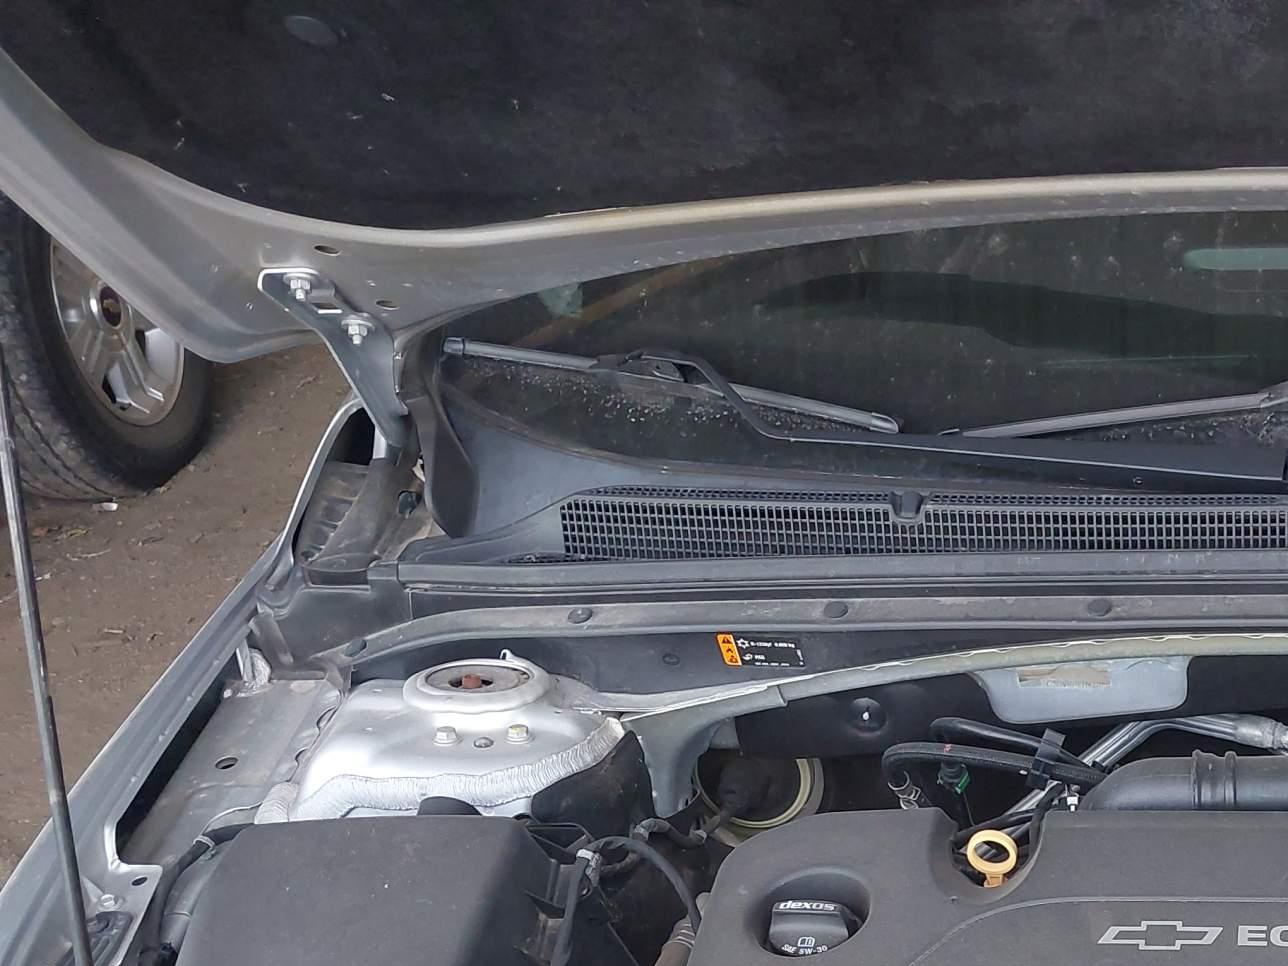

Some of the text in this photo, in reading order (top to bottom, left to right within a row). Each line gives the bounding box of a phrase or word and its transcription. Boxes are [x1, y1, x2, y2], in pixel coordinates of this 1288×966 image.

[779, 900, 835, 911] dexos
[781, 943, 828, 955] SAE 5W-30
